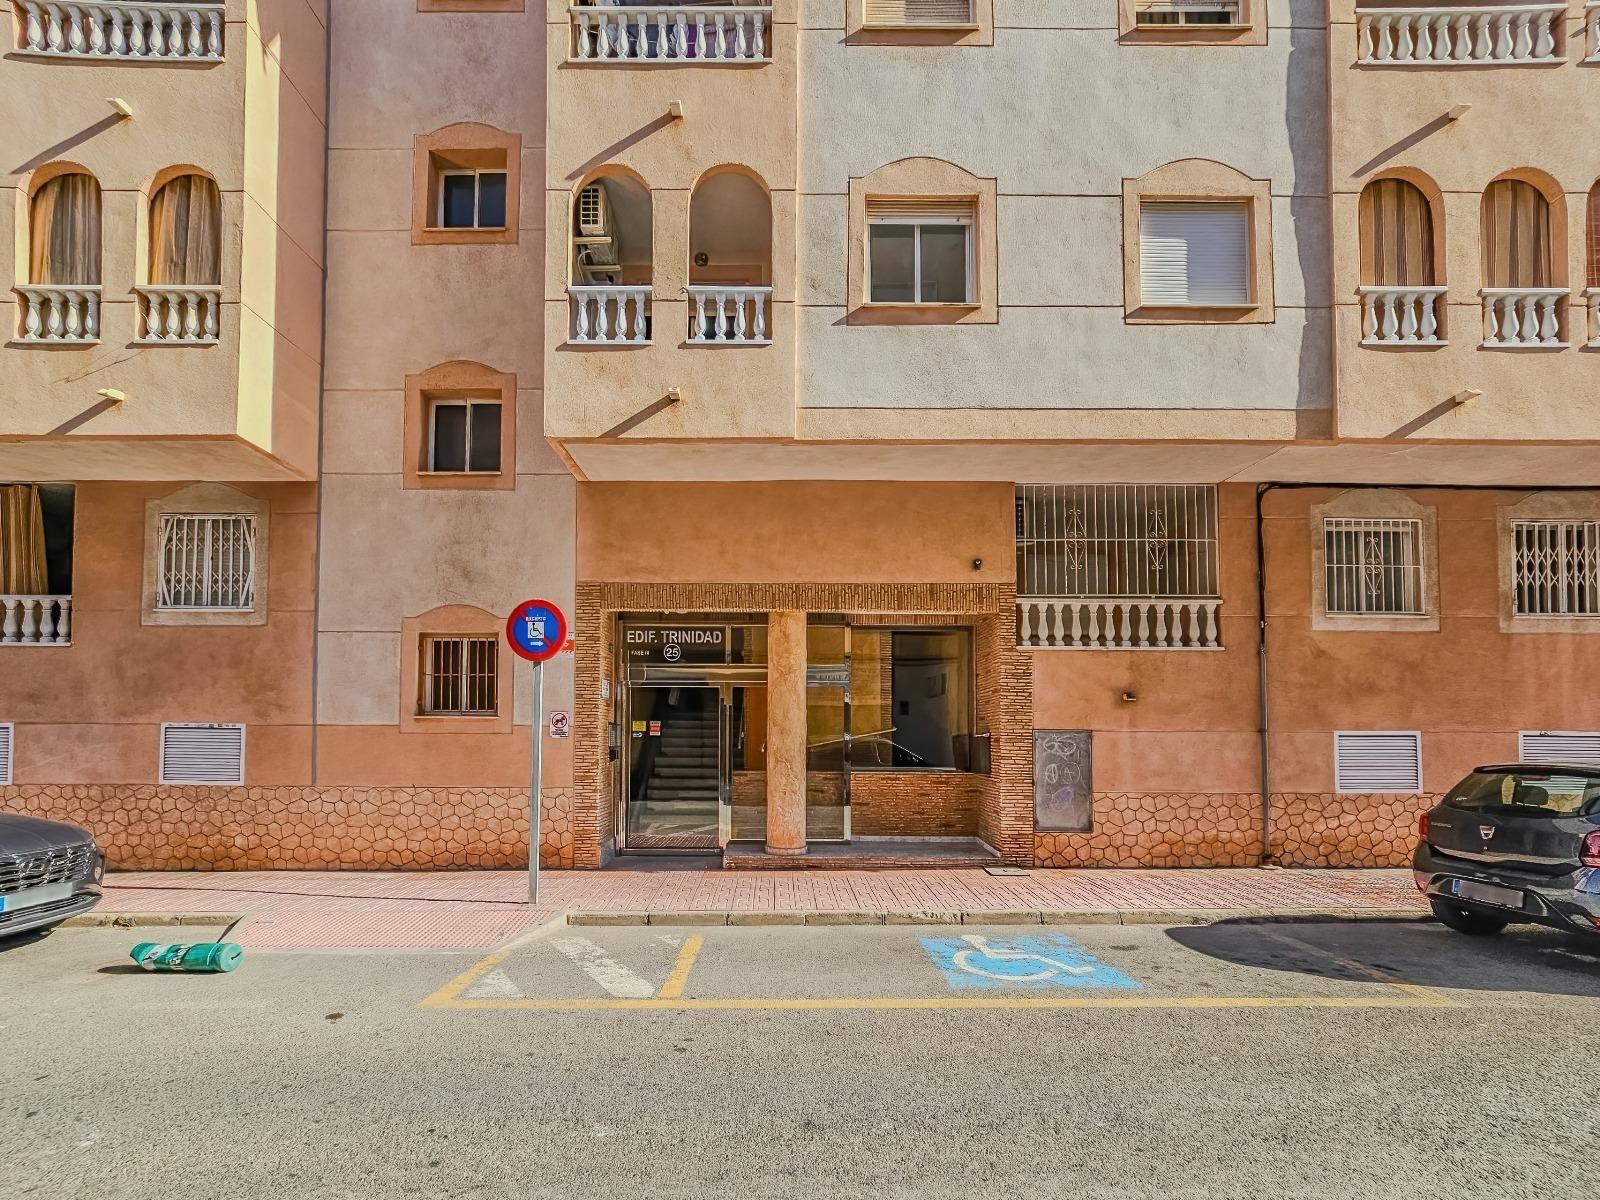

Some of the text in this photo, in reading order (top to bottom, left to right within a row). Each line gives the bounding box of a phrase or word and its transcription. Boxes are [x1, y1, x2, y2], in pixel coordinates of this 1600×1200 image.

[627, 630, 722, 644] EDIF. TRINIDAD
[665, 647, 679, 657] 25
